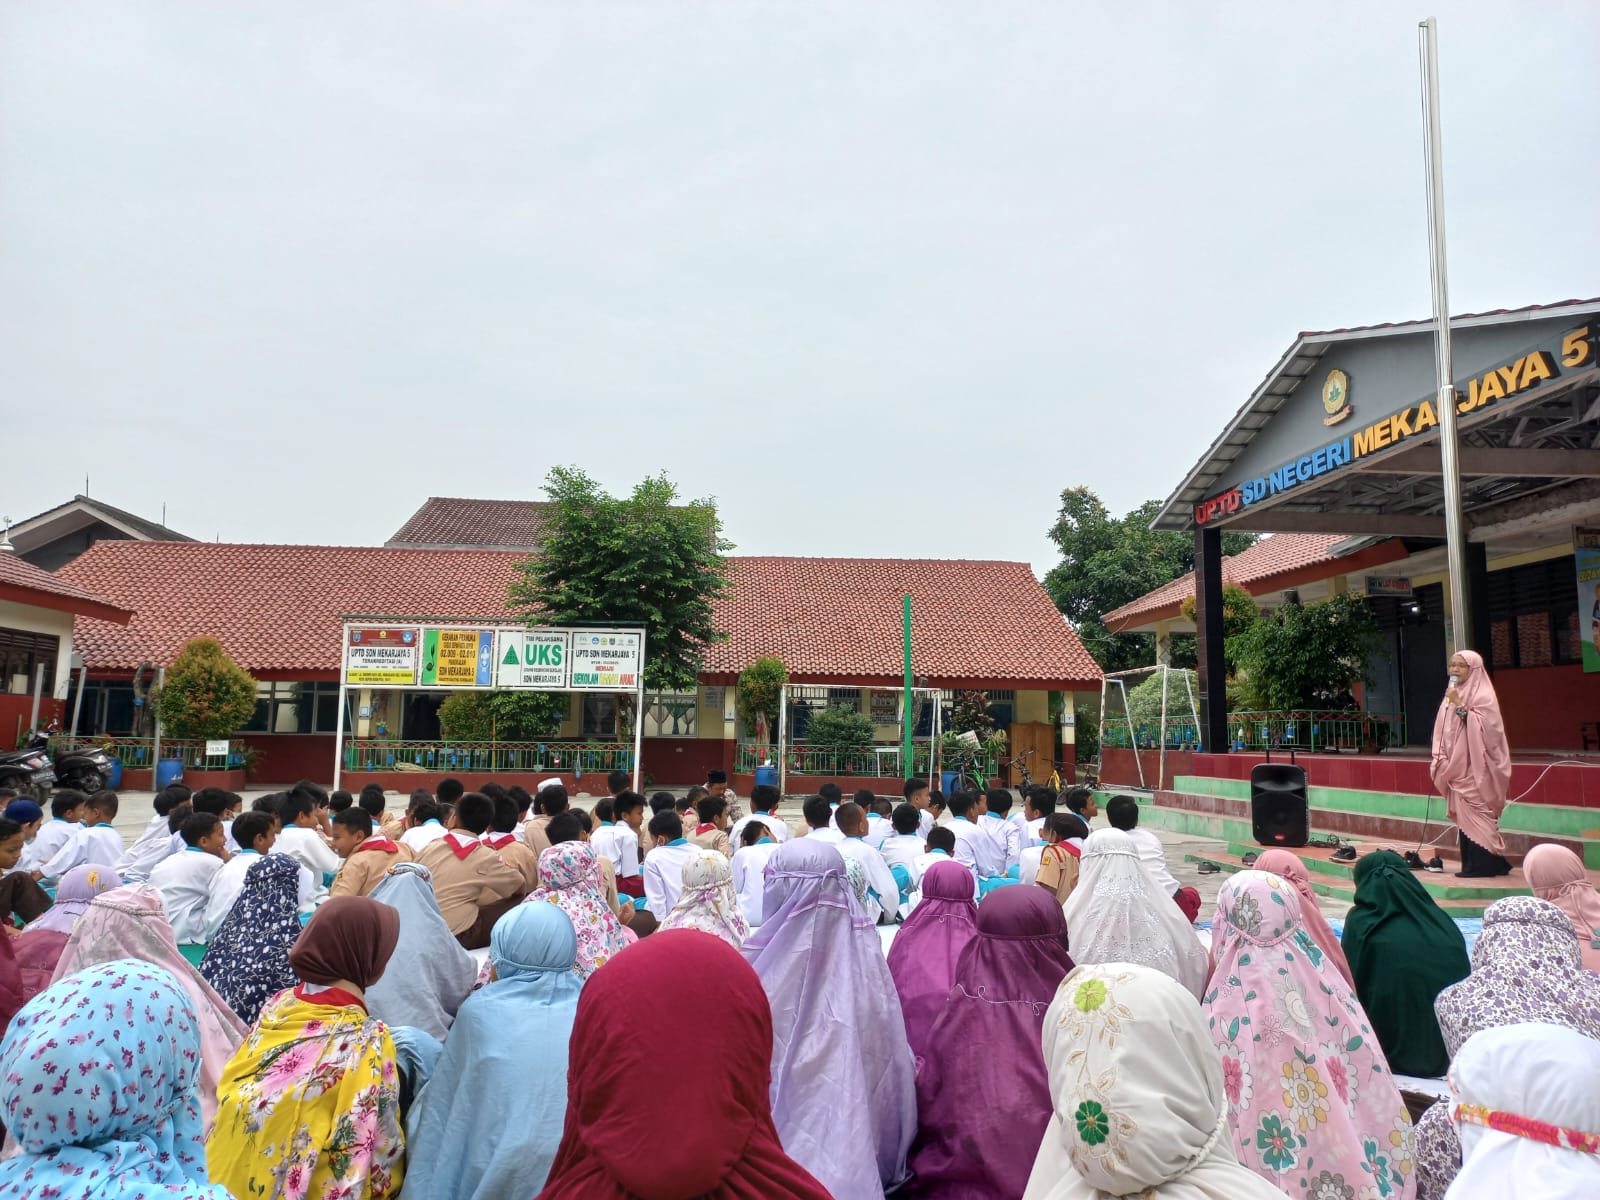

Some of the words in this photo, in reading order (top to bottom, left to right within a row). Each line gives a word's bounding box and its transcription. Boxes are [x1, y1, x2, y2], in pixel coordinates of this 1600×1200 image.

[1195, 488, 1240, 525] UPTD
[1241, 477, 1267, 505] SD
[1269, 438, 1351, 494] NEGERI
[1561, 326, 1589, 368] 5
[351, 648, 364, 658] UPTD
[366, 648, 376, 658] SDN
[378, 648, 406, 658] MEKARJAYA
[407, 649, 411, 658] 5
[526, 644, 562, 666] UKS
[576, 650, 589, 658] UPTD
[601, 650, 630, 658] MEKARJAYA
[448, 667, 471, 676] MEKARJAYA
[533, 675, 557, 683] MEKARJAYA
[574, 672, 598, 684] SEKOLAH
[619, 674, 635, 685] ANAK
